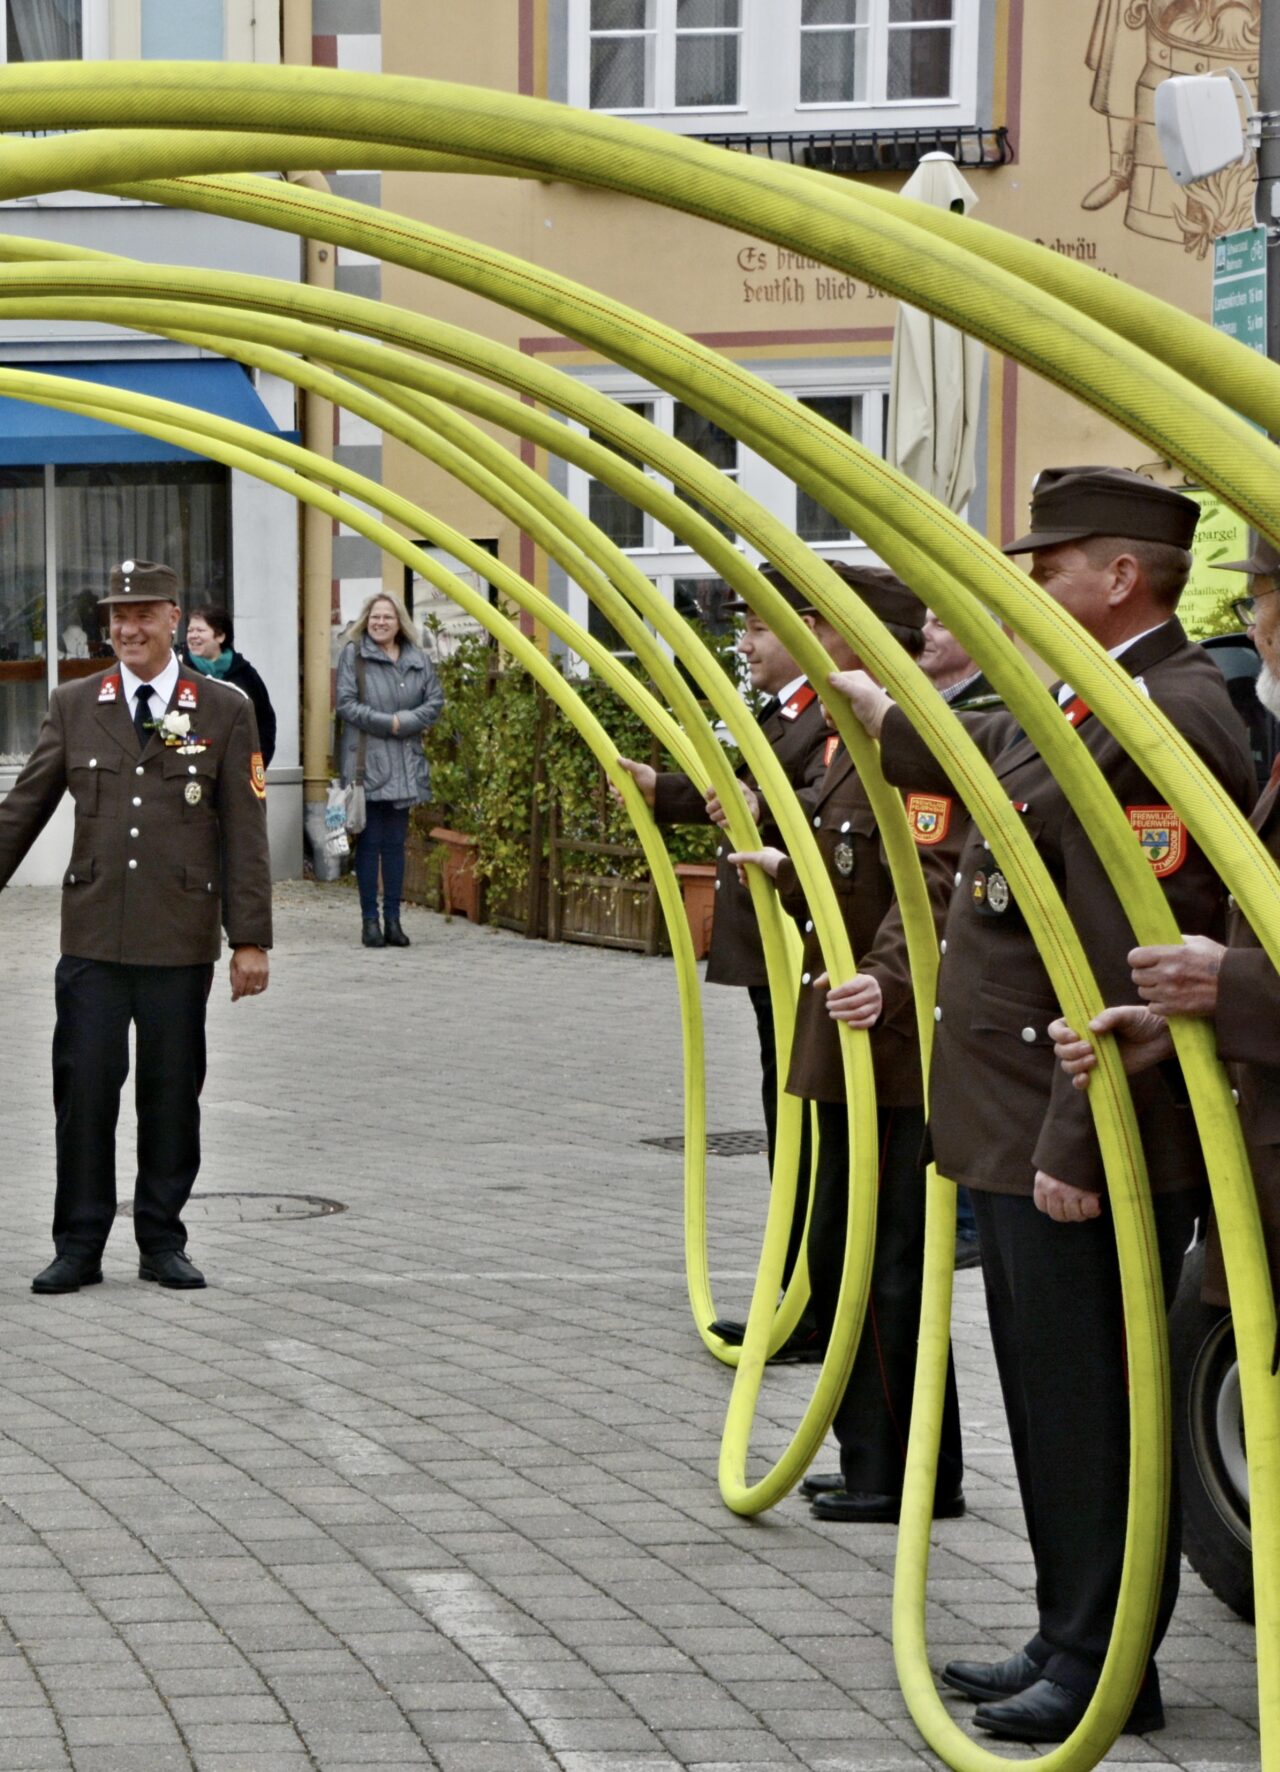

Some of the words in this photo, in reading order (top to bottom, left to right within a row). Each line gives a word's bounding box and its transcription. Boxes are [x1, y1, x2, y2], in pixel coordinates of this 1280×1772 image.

[737, 247, 767, 272] Es
[815, 276, 856, 300] blieb
[1132, 820, 1179, 828] FEUERWEHR
